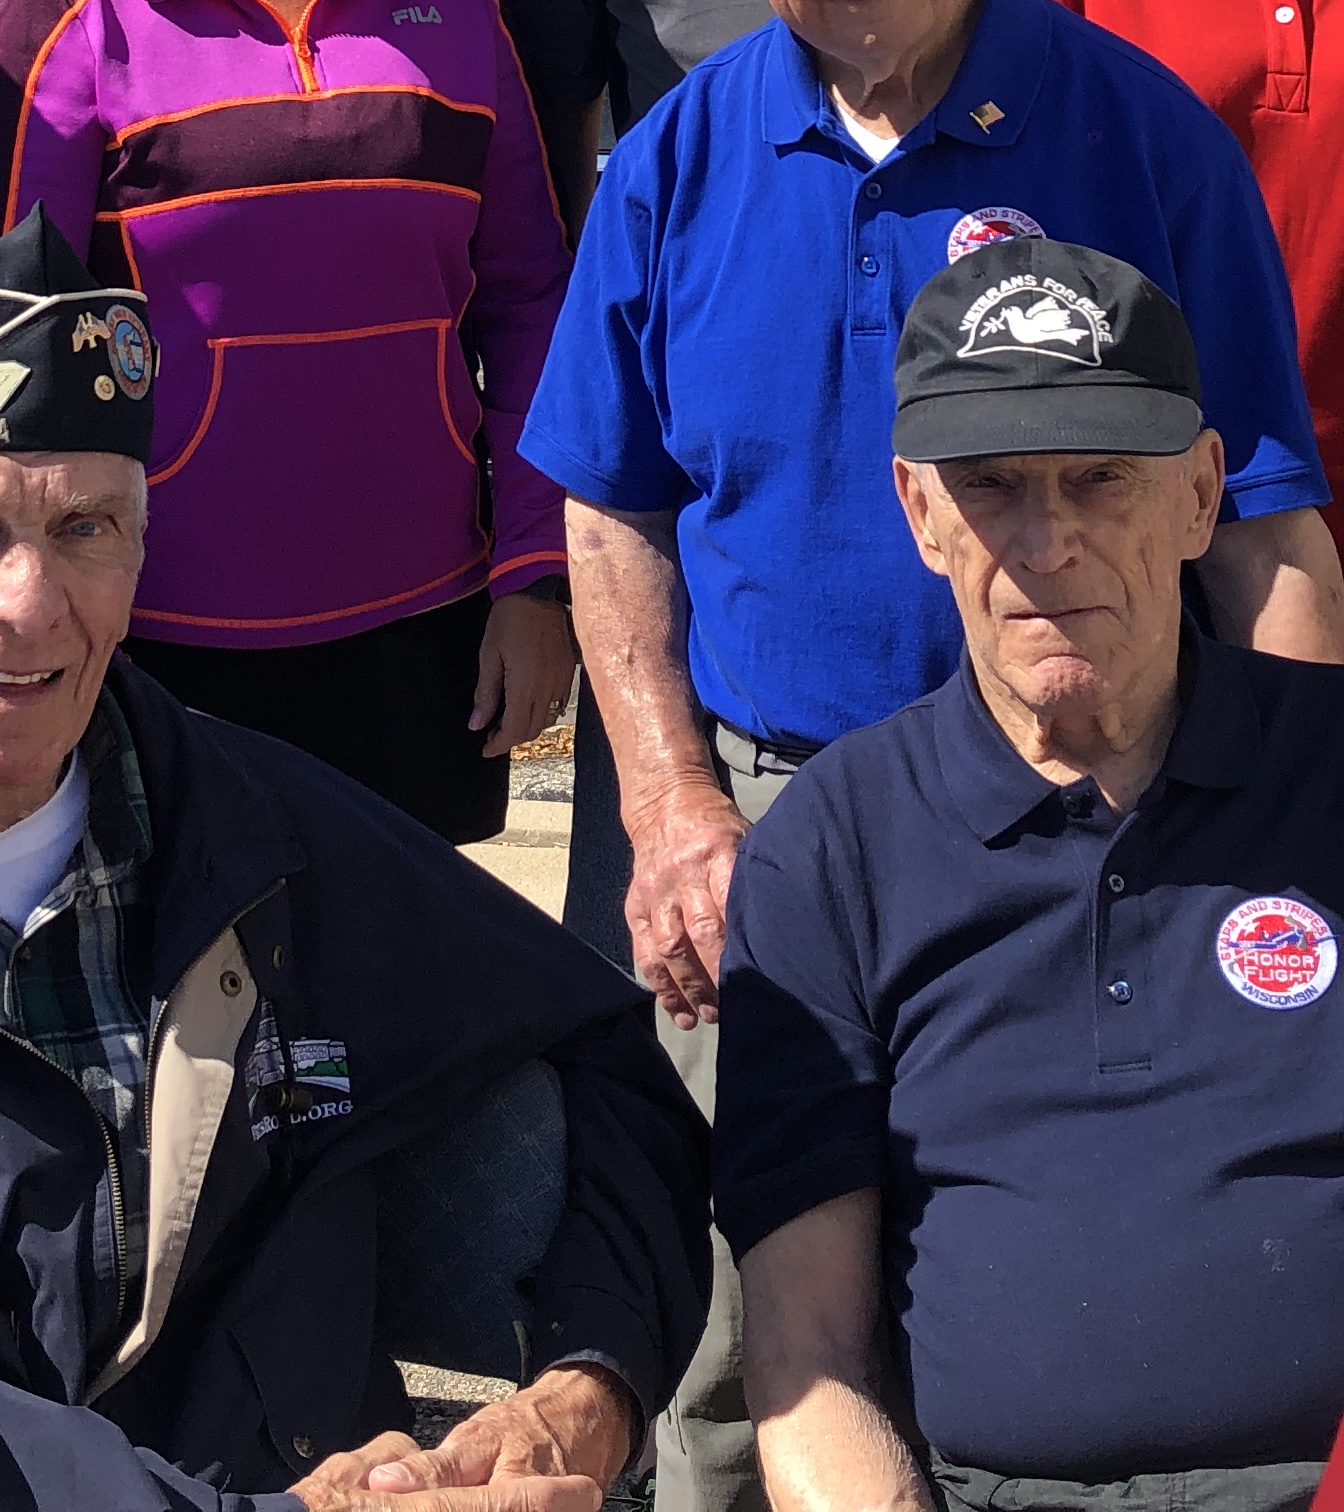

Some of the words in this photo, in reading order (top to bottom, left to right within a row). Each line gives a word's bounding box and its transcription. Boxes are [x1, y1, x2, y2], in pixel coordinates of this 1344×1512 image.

[392, 5, 443, 26] FILA
[971, 209, 997, 223] AND
[958, 273, 1038, 332] VETERANS
[1043, 277, 1078, 302] FOR
[1075, 296, 1114, 344] PEACE
[1220, 918, 1239, 961] STARS
[1238, 901, 1268, 919] AND
[1272, 900, 1328, 936] STRIPES
[1243, 951, 1315, 968] HONOR
[1244, 965, 1315, 982] FLIGHT
[1241, 981, 1319, 1006] WISCONSIN
